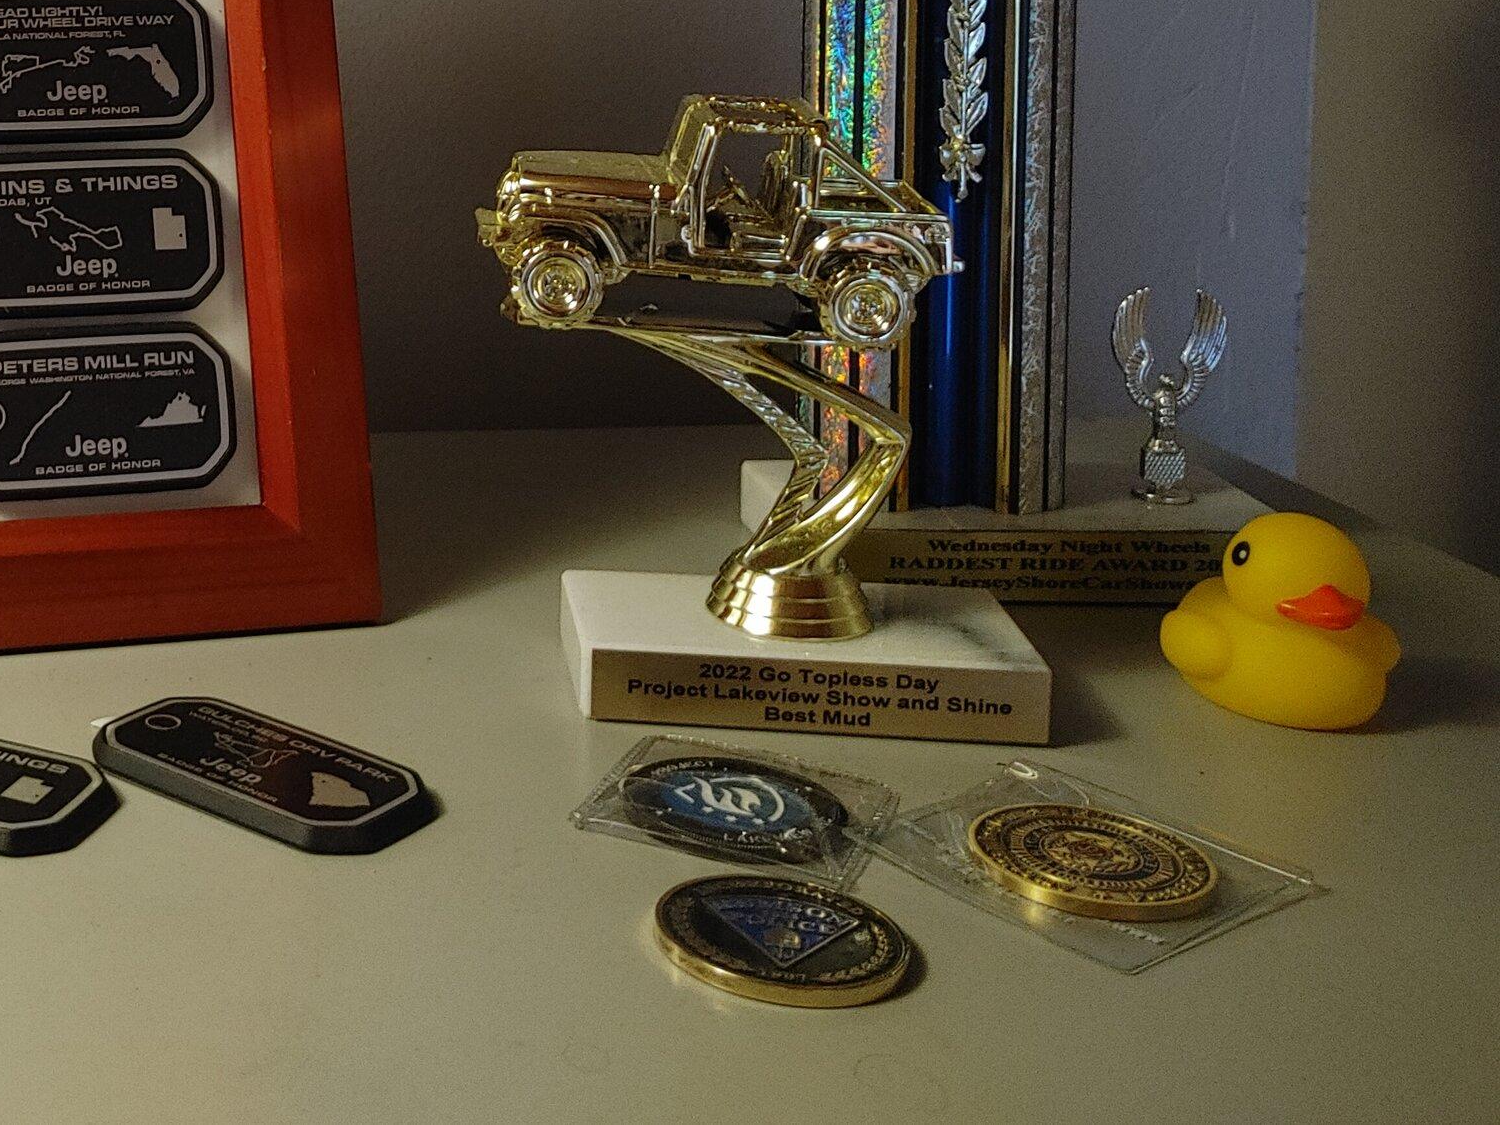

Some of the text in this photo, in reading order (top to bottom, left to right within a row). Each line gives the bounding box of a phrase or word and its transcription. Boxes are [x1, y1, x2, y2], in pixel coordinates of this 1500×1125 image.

[32, 6, 103, 17] LIGHTLY!
[22, 17, 81, 28] WHEEL
[85, 16, 134, 26] DRIVE
[136, 15, 174, 25] WAY
[12, 32, 67, 40] NATIONAL
[17, 106, 140, 117] BADGE OF HONOR
[55, 177, 73, 193] &
[81, 174, 178, 191] THINGS
[34, 196, 52, 206] UT
[26, 280, 150, 293] BADGE OF HONOR
[84, 354, 138, 370] MILL
[144, 351, 194, 365] RUN
[30, 374, 93, 385] WASHINGTON
[96, 372, 142, 380] NATIONAL
[35, 459, 161, 475] BADGE OF HONOR
[1061, 541, 1123, 555] Night
[889, 557, 1223, 572] RADDEST RIDE AWARD 20
[699, 664, 939, 693] 2022 Go Topless Day
[627, 679, 1012, 716] Project Lakeview Show and Shine
[764, 707, 871, 727] Best Mud
